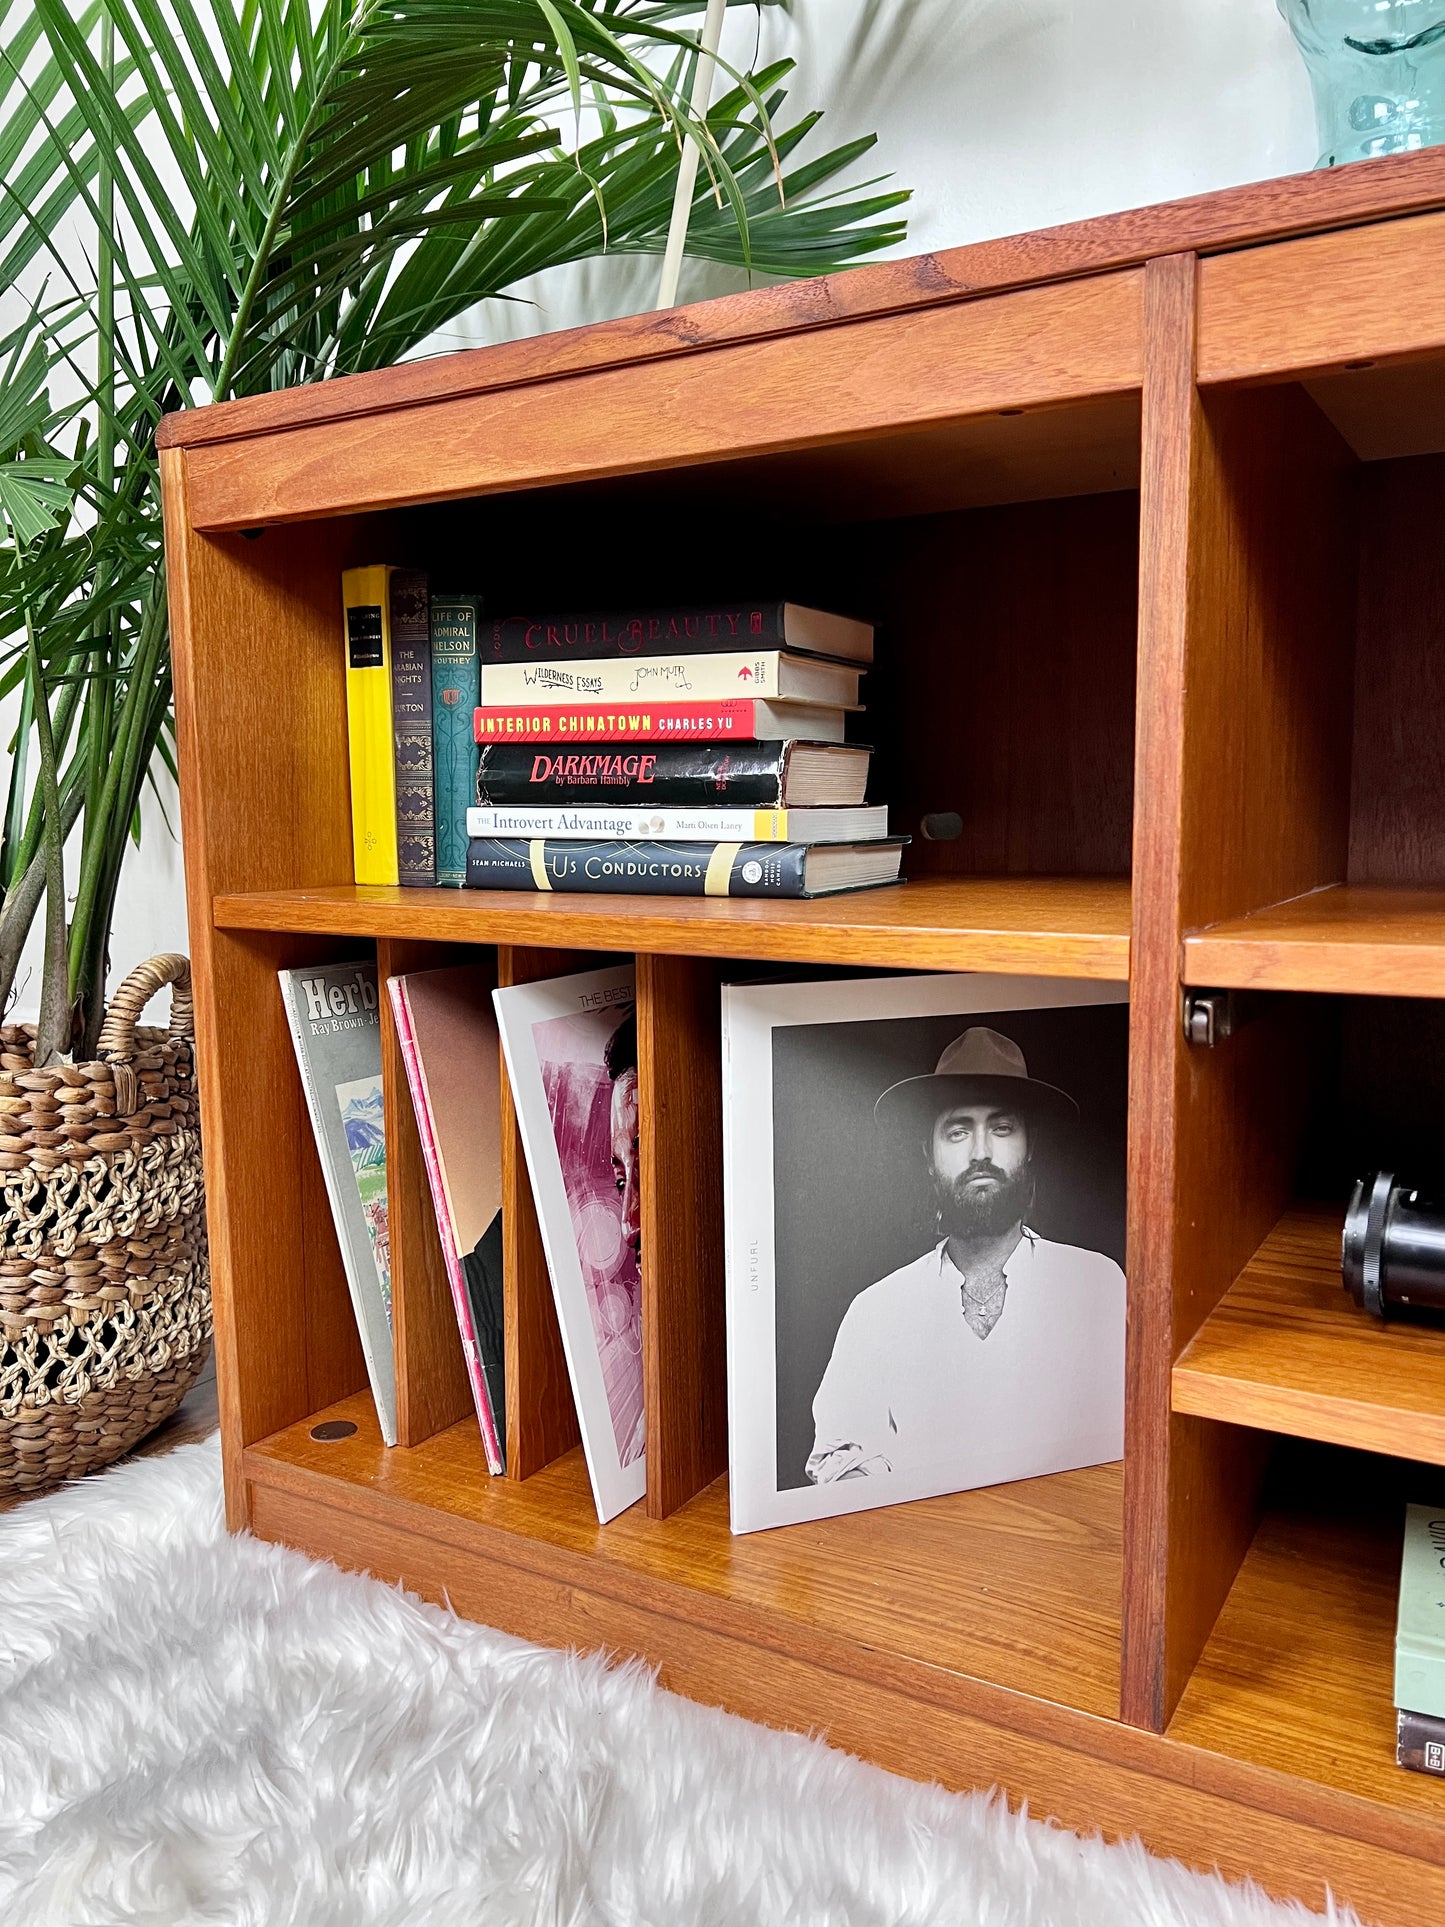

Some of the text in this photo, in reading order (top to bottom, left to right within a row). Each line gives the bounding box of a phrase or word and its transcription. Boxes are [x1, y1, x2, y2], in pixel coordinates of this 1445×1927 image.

[432, 612, 473, 621] LIFE OF
[433, 627, 470, 637] ADMIRAL
[524, 622, 613, 649] CRUEL
[617, 612, 742, 652] BEAUTY
[399, 650, 415, 659] THE
[433, 641, 470, 651] NELSON
[524, 668, 602, 691] WILDERNESS ESSAYS
[630, 665, 693, 692] JOHN MUIR
[480, 715, 651, 733] INTERIOR CHINATOWN
[658, 717, 732, 731] CHARLES YU
[529, 755, 657, 784] DARKMAGE
[556, 775, 631, 787] by Barbara Hambly
[477, 813, 633, 836] THE Introvert Advantage
[676, 820, 742, 832] Marti Olsen Laney
[491, 860, 526, 868] MICHAELS
[585, 857, 701, 879] CONDUCTORS
[301, 971, 378, 1021] Herb
[578, 986, 633, 1008] THE BEST
[310, 1022, 330, 1036] Ray
[331, 1016, 364, 1033] Brown
[750, 1239, 759, 1292] UNFURL
